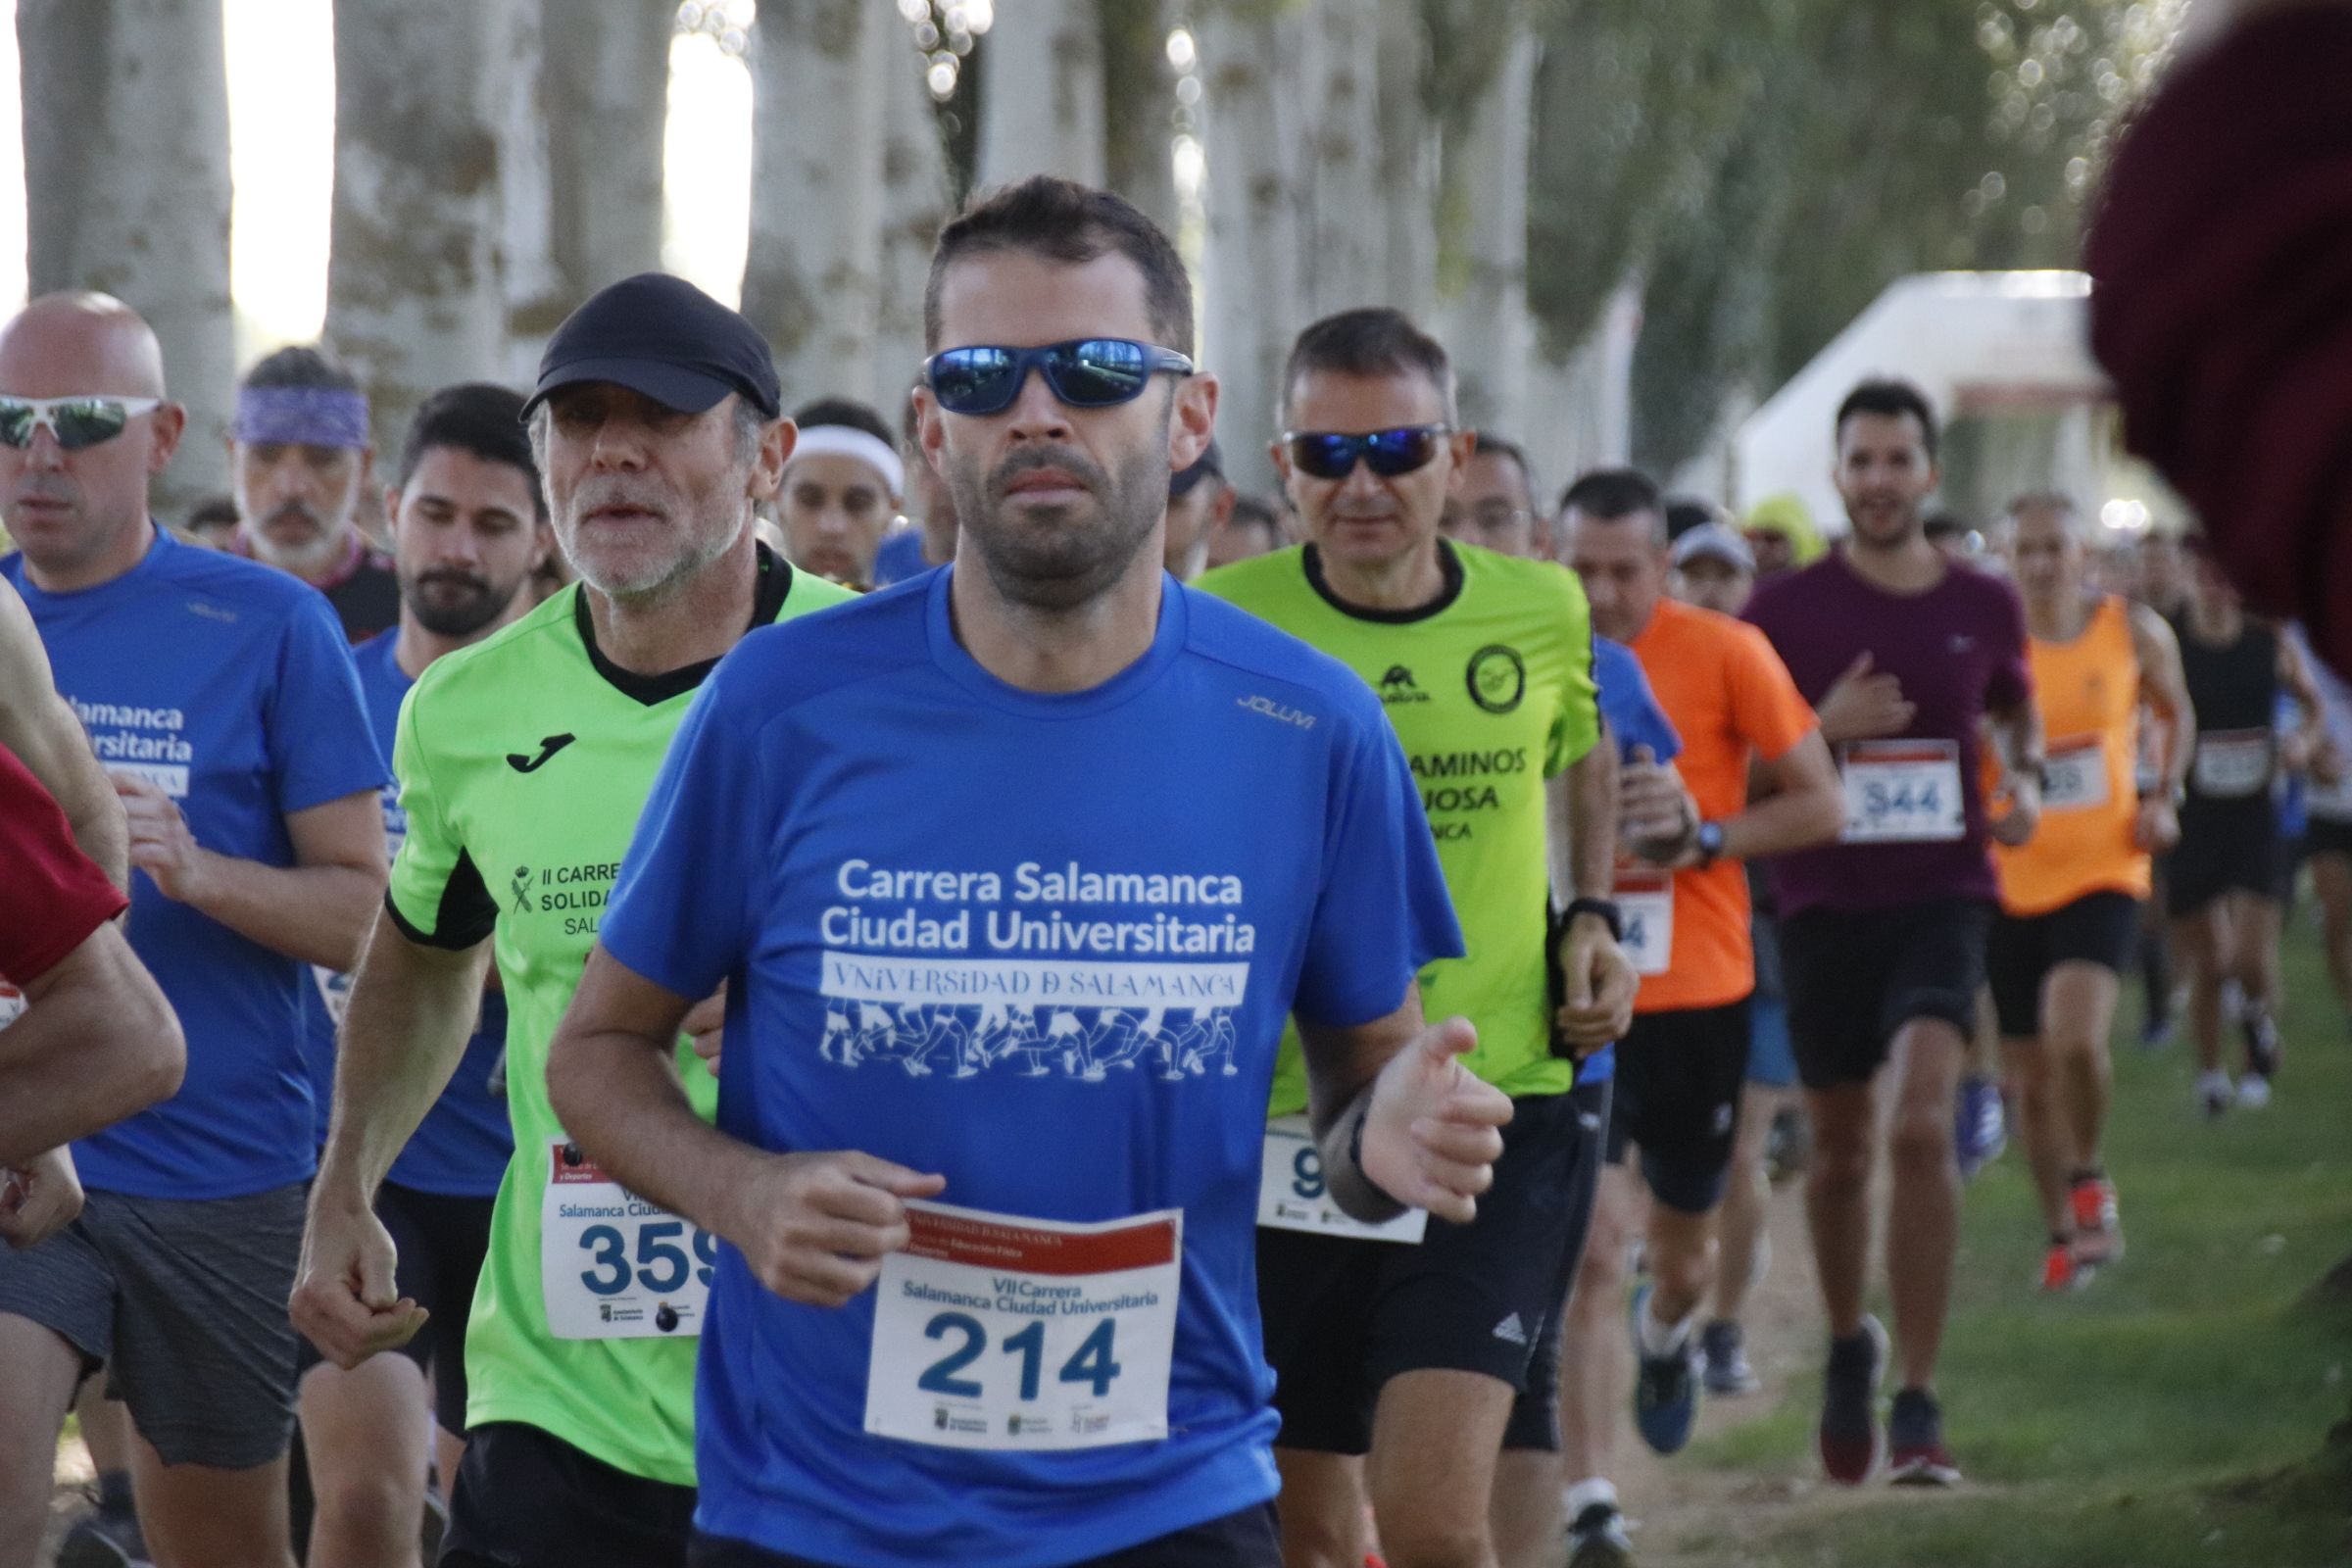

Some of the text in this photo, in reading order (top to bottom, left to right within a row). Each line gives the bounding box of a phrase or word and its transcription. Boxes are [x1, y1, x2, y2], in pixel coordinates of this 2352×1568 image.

[542, 868, 552, 885] II
[838, 858, 1243, 905] Carrera Salamanca
[821, 906, 1256, 954] Ciudad Universitaria
[1069, 971, 1236, 997] SALAMANCA
[560, 1204, 625, 1217] Salamanca
[902, 1280, 1158, 1316] Salamanca Ciudad Universitaria
[993, 1277, 1082, 1298] VII Carrera
[917, 1311, 1121, 1401] 214
